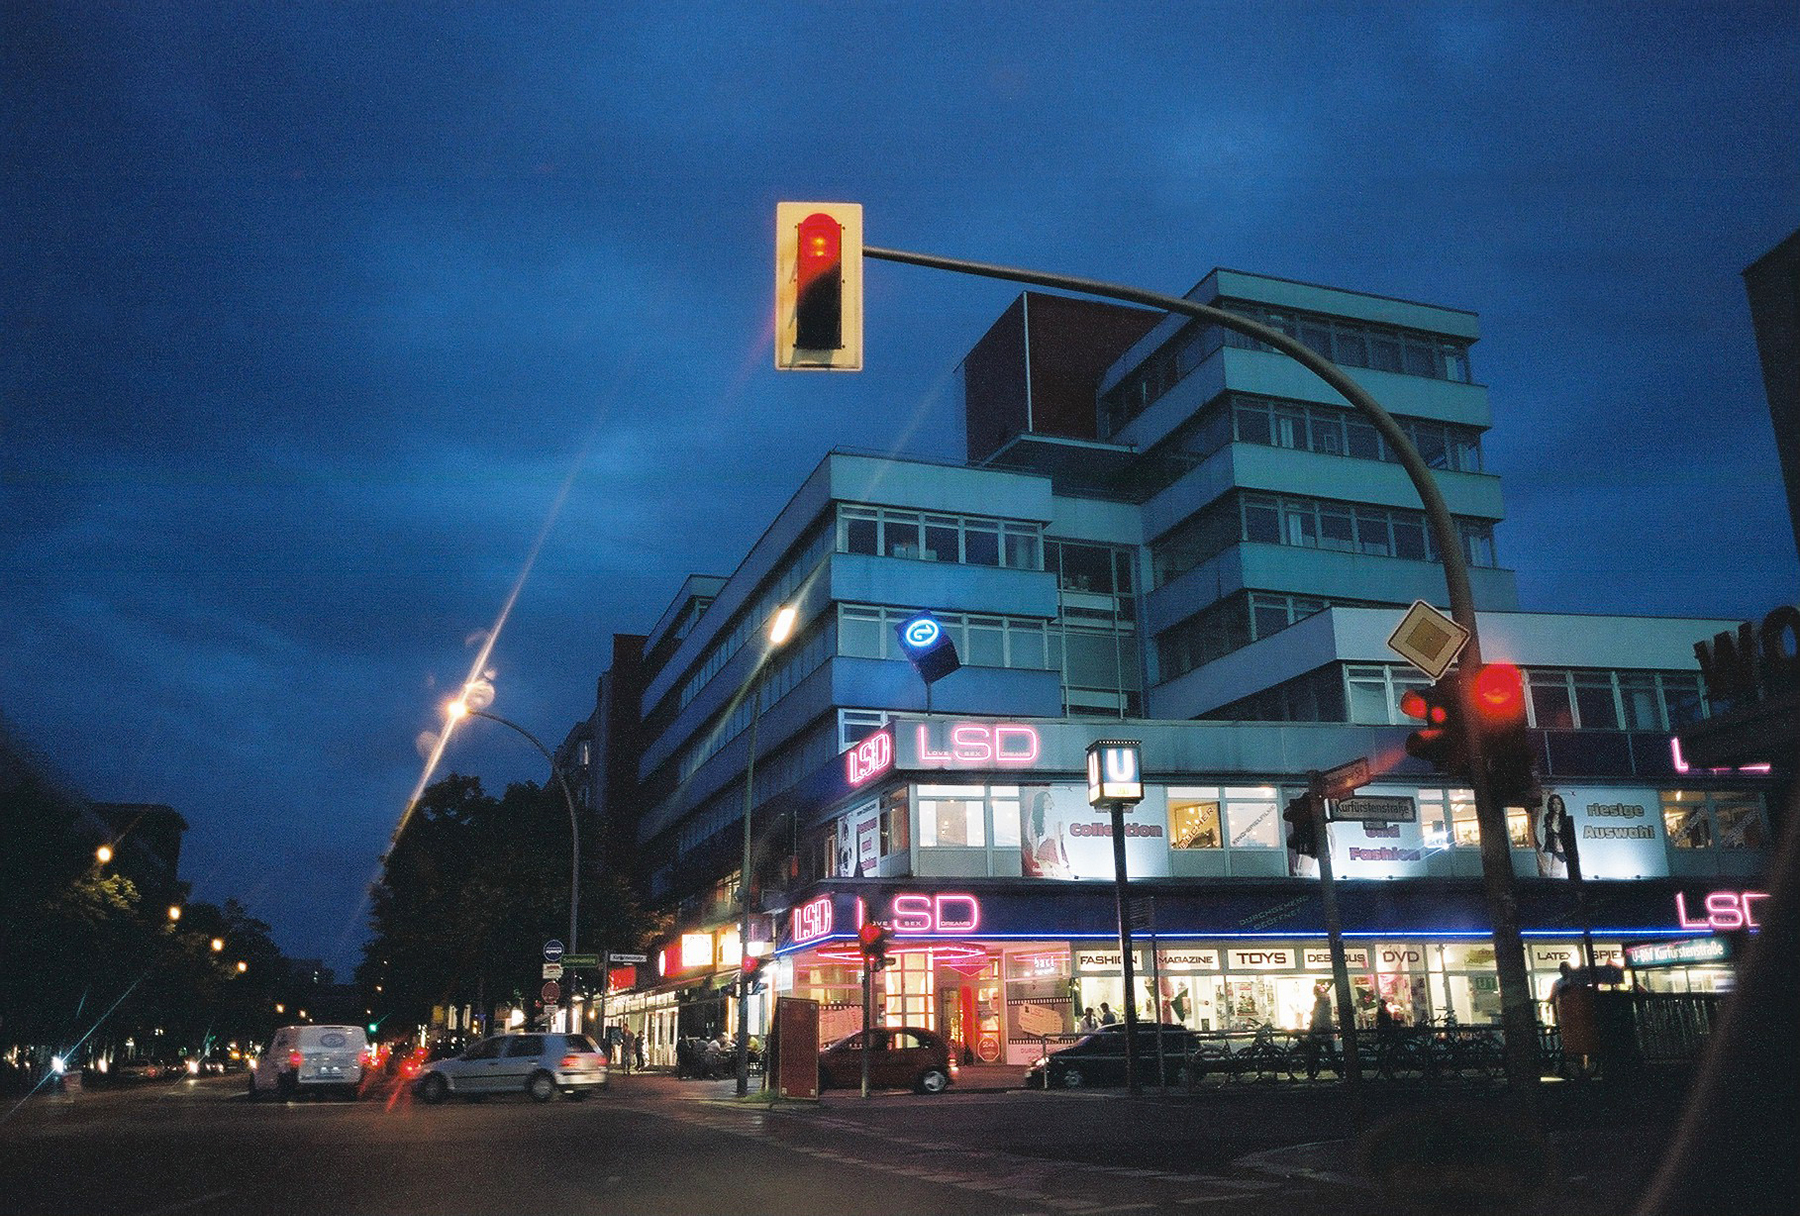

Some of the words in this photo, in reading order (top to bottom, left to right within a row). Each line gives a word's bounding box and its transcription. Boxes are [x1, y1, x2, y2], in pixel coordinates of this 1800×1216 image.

[919, 725, 1039, 762] LSD
[848, 732, 891, 784] LSD
[1106, 748, 1135, 782] U
[1335, 800, 1410, 816] Kurfürstenstraße
[1586, 803, 1645, 820] riesige
[1070, 822, 1163, 838] Colletion
[1583, 825, 1656, 840] Auswahl
[1349, 847, 1421, 861] Fashion
[793, 898, 832, 942] LSD
[1383, 950, 1420, 963] DVD
[1537, 951, 1573, 961] LATEX
[1592, 950, 1624, 960] SPIE
[1655, 940, 1724, 959] Kurfürstenstraße
[1158, 955, 1213, 964] MAGAZINE
[1236, 952, 1287, 964] TOYS
[1307, 953, 1366, 963] DESOUS
